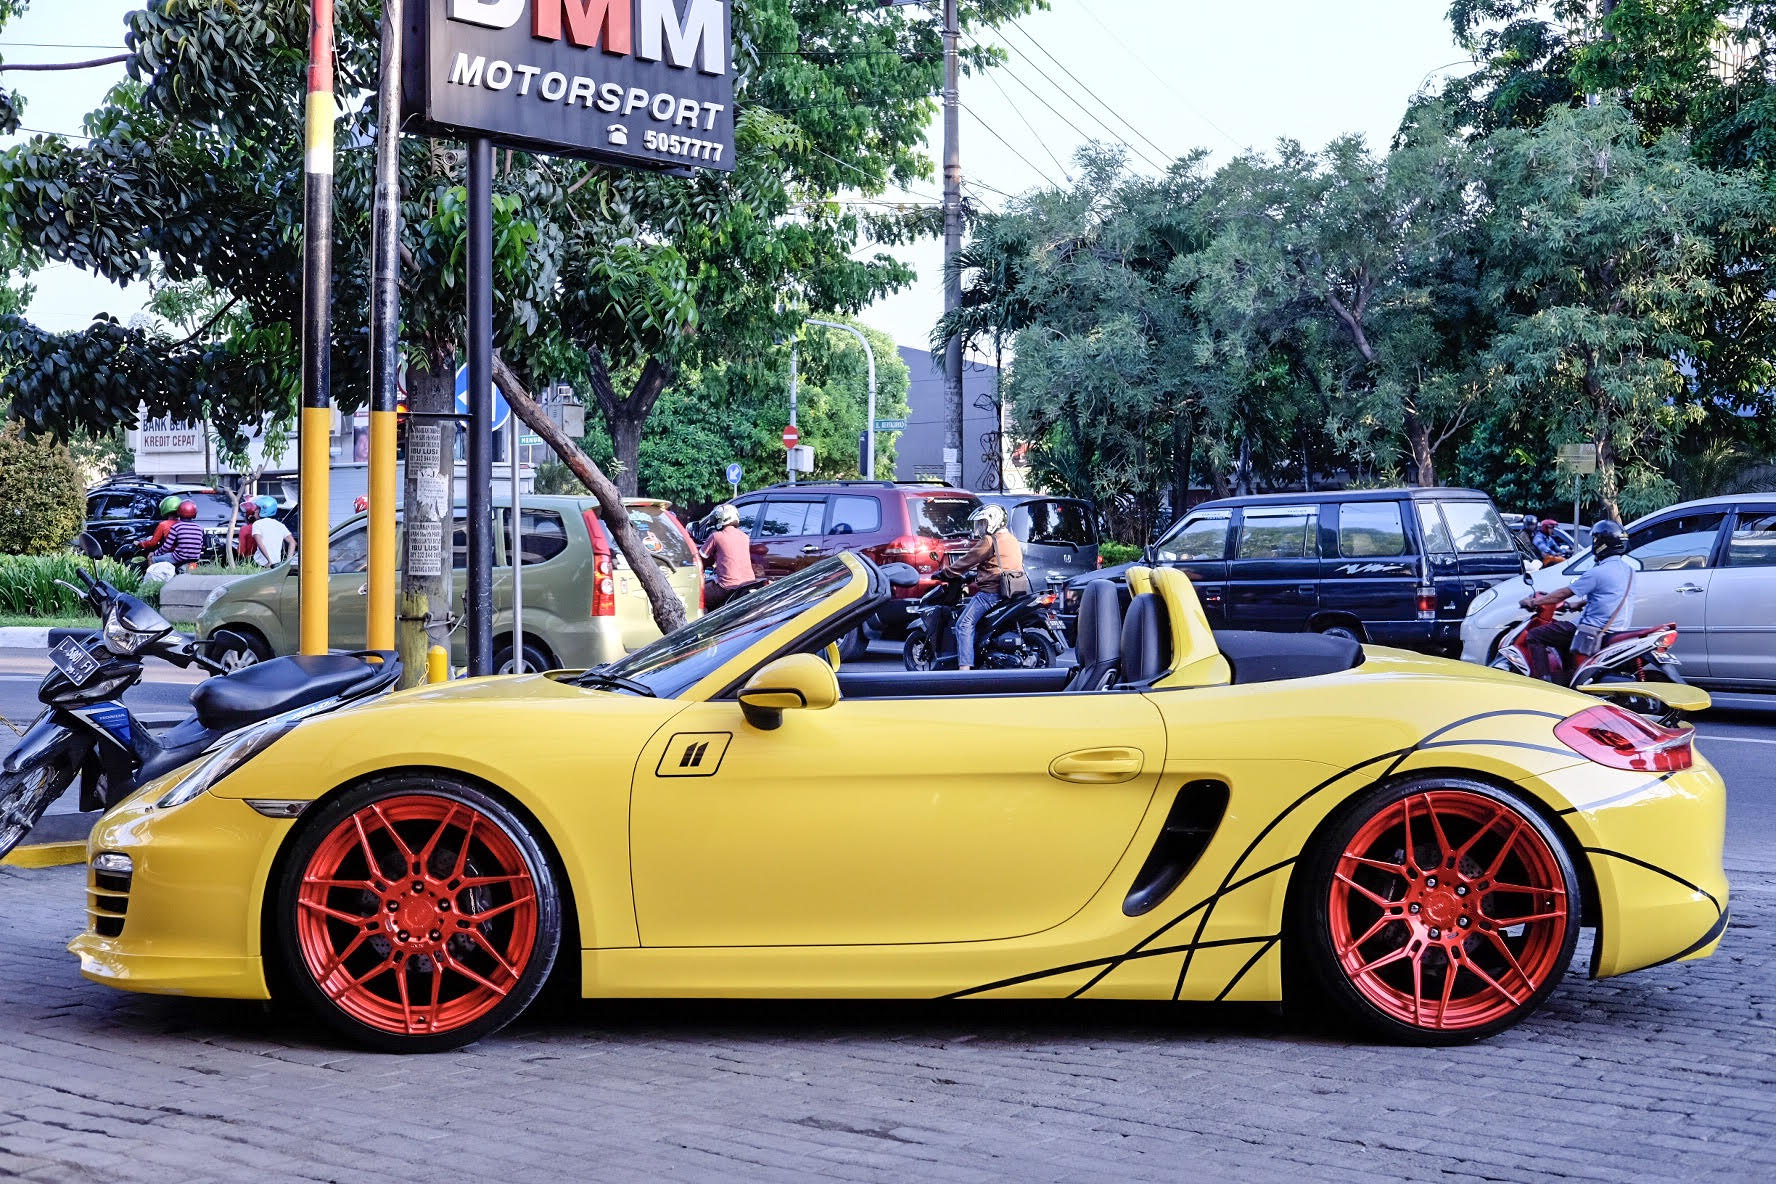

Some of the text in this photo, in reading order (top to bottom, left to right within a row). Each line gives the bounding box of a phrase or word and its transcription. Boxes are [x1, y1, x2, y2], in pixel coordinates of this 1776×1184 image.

[449, 52, 724, 130] MOTORSPORT
[643, 130, 723, 162] 5057777
[143, 418, 197, 432] BANK BENA
[144, 435, 196, 447] KREDIT CEPAT
[59, 640, 69, 651] L
